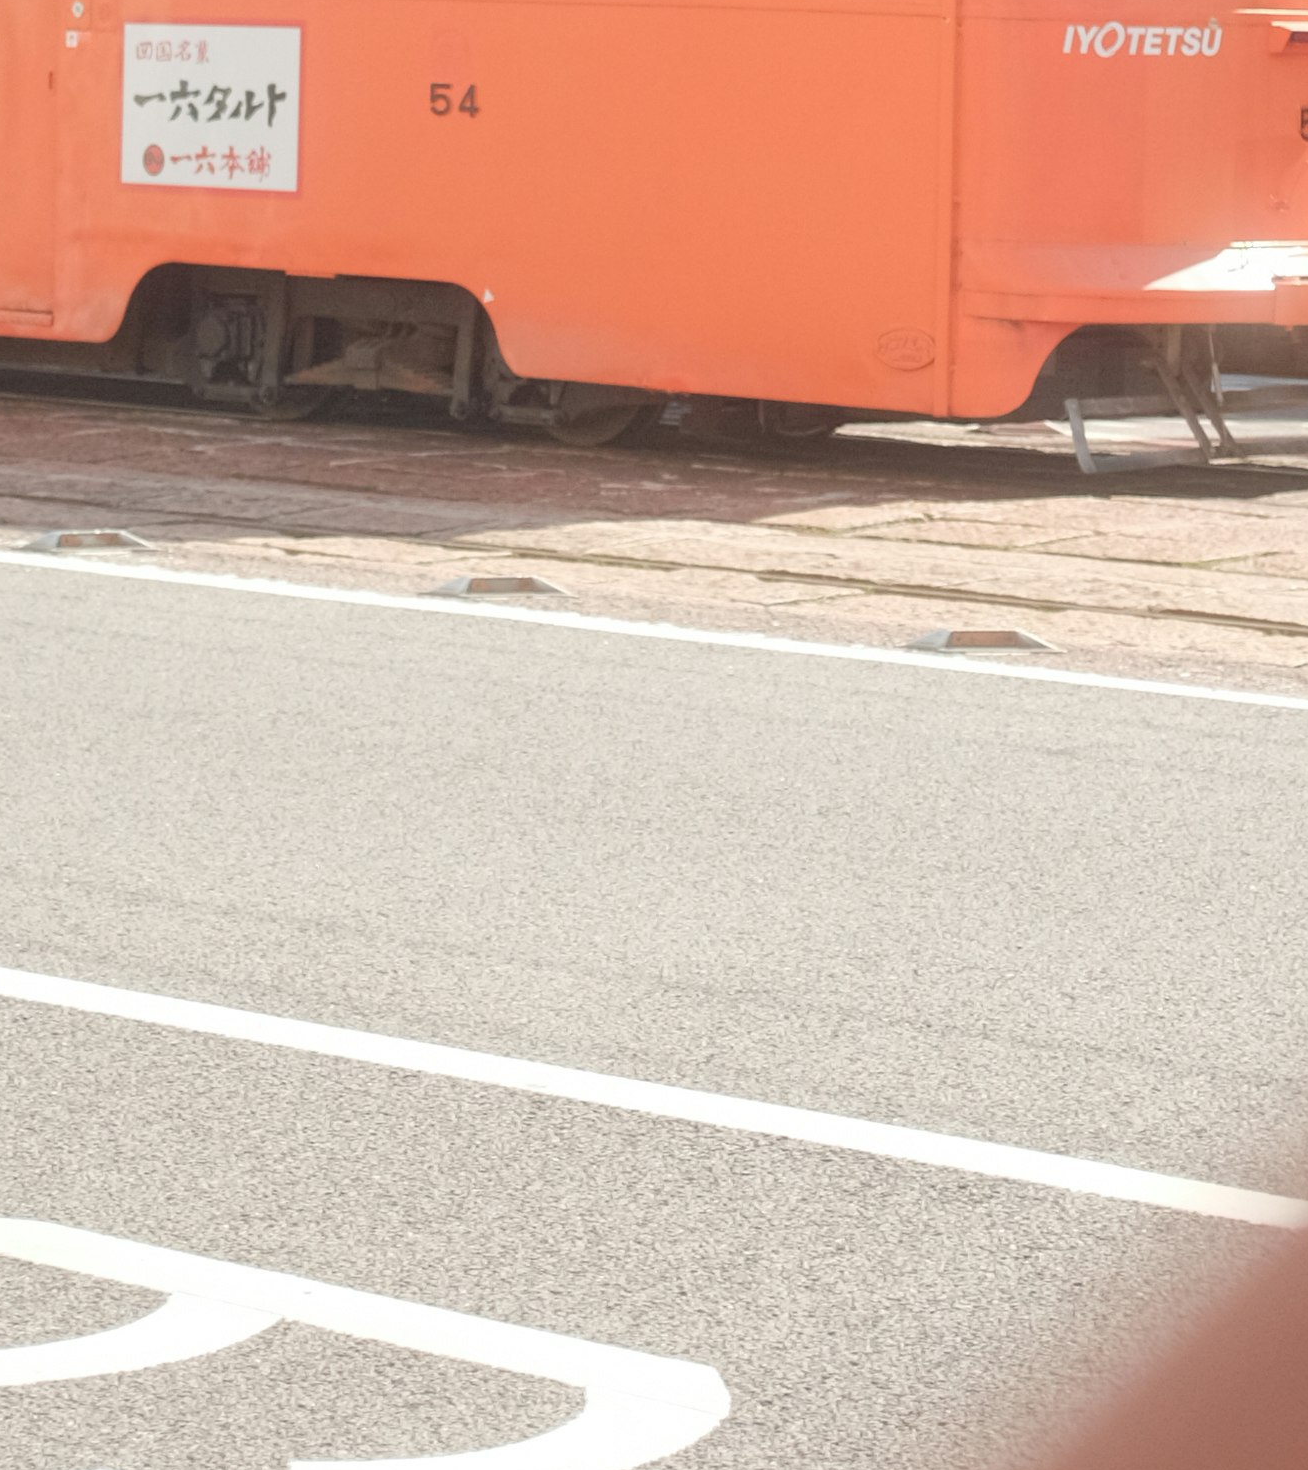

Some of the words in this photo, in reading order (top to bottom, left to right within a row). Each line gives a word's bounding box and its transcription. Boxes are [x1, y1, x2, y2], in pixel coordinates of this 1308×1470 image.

[1063, 20, 1222, 58] IYOTETSU
[133, 79, 287, 128] 一六タルト
[430, 82, 480, 118] 54
